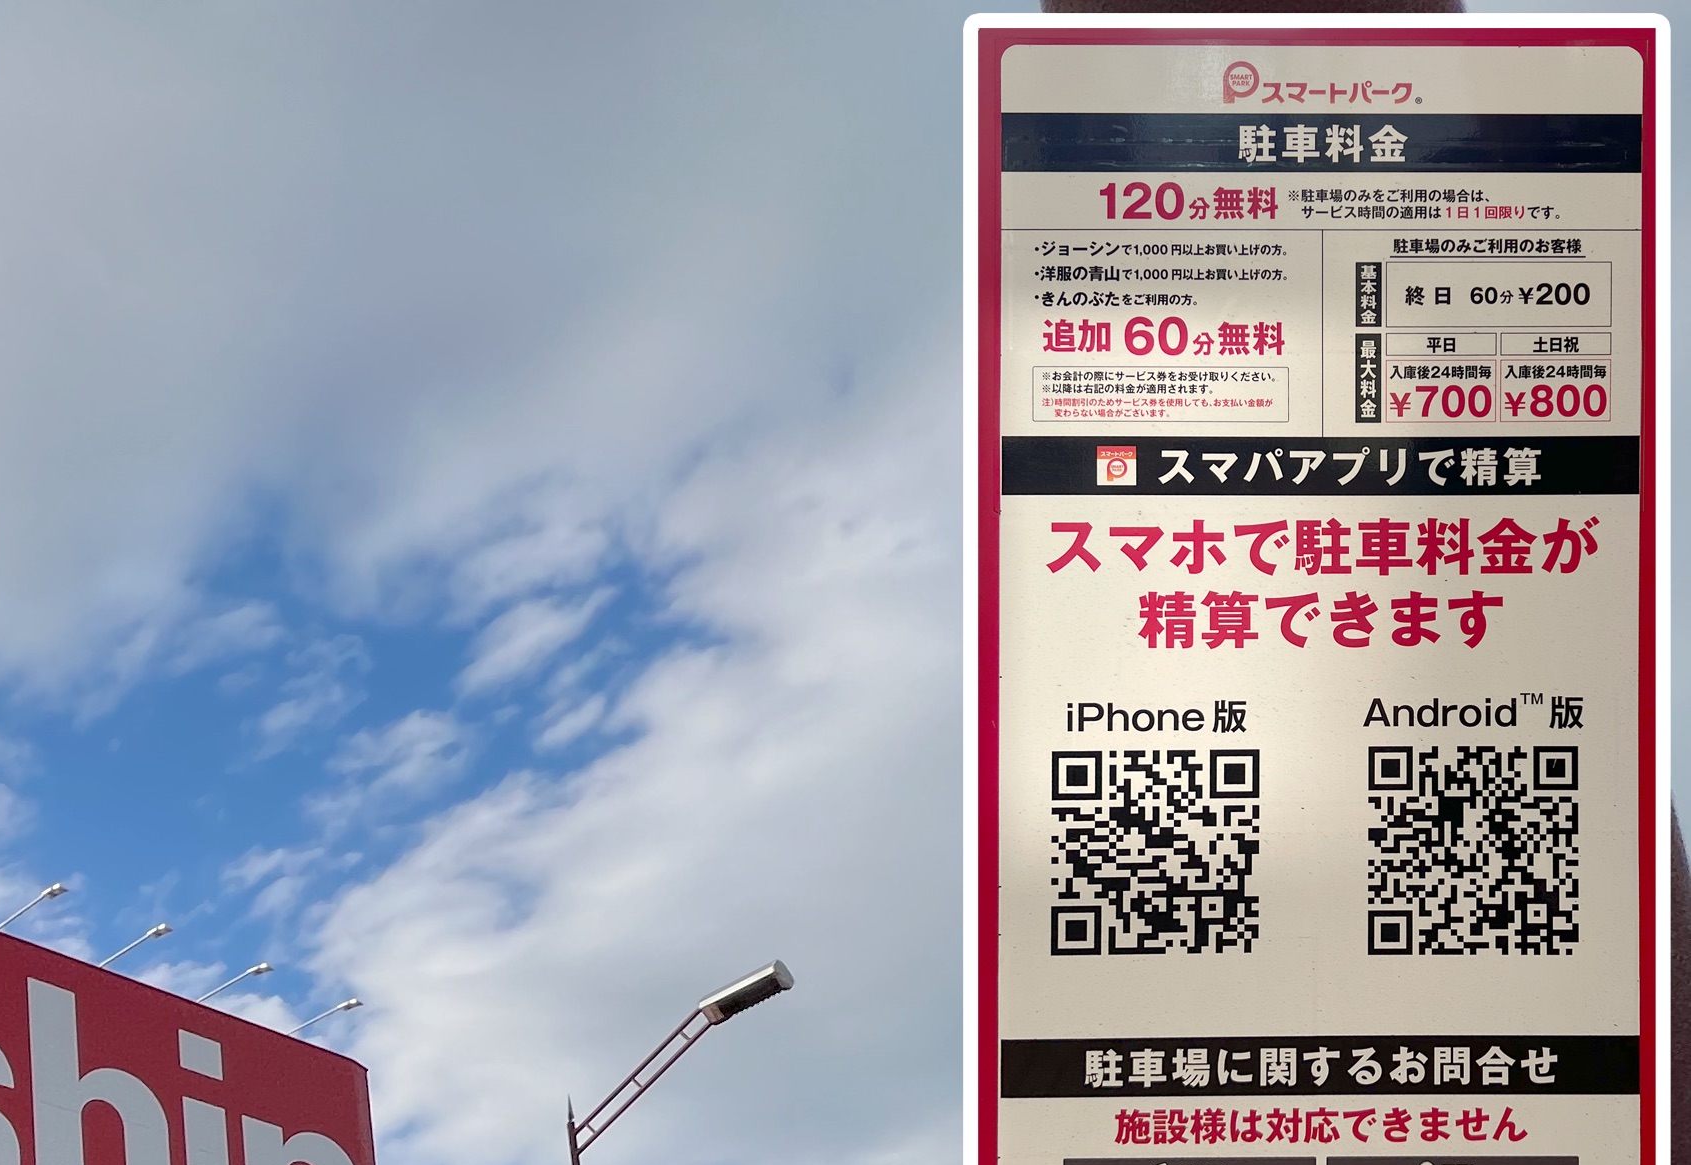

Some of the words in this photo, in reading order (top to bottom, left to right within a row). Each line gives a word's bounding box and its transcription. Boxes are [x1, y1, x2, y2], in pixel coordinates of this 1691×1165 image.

[1261, 80, 1413, 104] スマートパーク
[1238, 124, 1409, 163] 駐車料金
[1393, 238, 1583, 254] 駐車場のみご利用のお客様
[1360, 264, 1377, 325] 基本料金
[1426, 337, 1457, 353] 平日
[1532, 336, 1580, 353] 土日祝
[1360, 340, 1377, 419] 最大料金
[1389, 364, 1492, 380] 入庫後24時間毎
[1504, 364, 1608, 380] 入庫後24時間毎
[1389, 384, 1493, 418] ¥700
[1504, 383, 1608, 418] ¥800
[1157, 446, 1543, 486] スマパアプリで精算
[1045, 516, 1599, 576] スマホで駐車料金が
[1138, 590, 1505, 650] 精算できます
[1084, 1046, 1560, 1089] 駐車場に関するお問合せ
[1113, 1106, 1529, 1145] 施設様は対応できません
